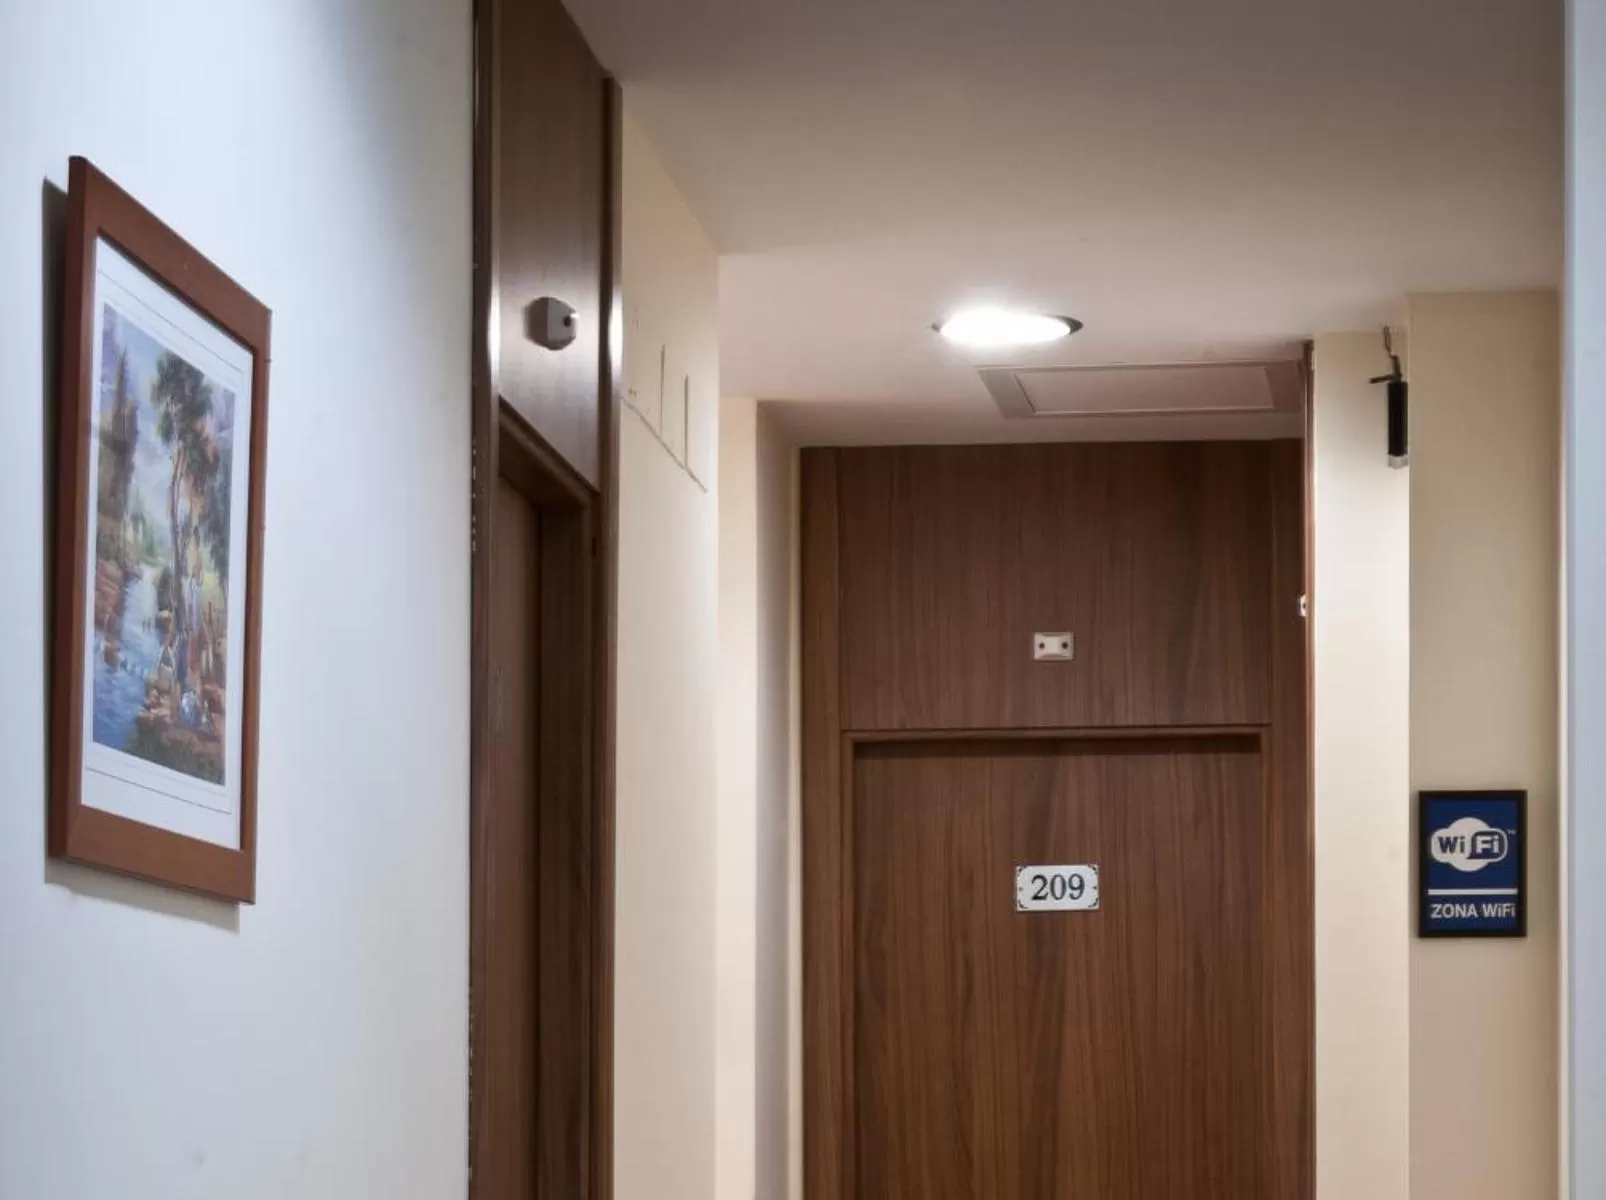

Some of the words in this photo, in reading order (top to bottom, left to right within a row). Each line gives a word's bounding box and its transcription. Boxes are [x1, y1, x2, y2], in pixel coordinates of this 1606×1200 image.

[1031, 873, 1085, 900] 209
[1430, 903, 1478, 919] ZONA
[1482, 902, 1516, 918] WiFi
